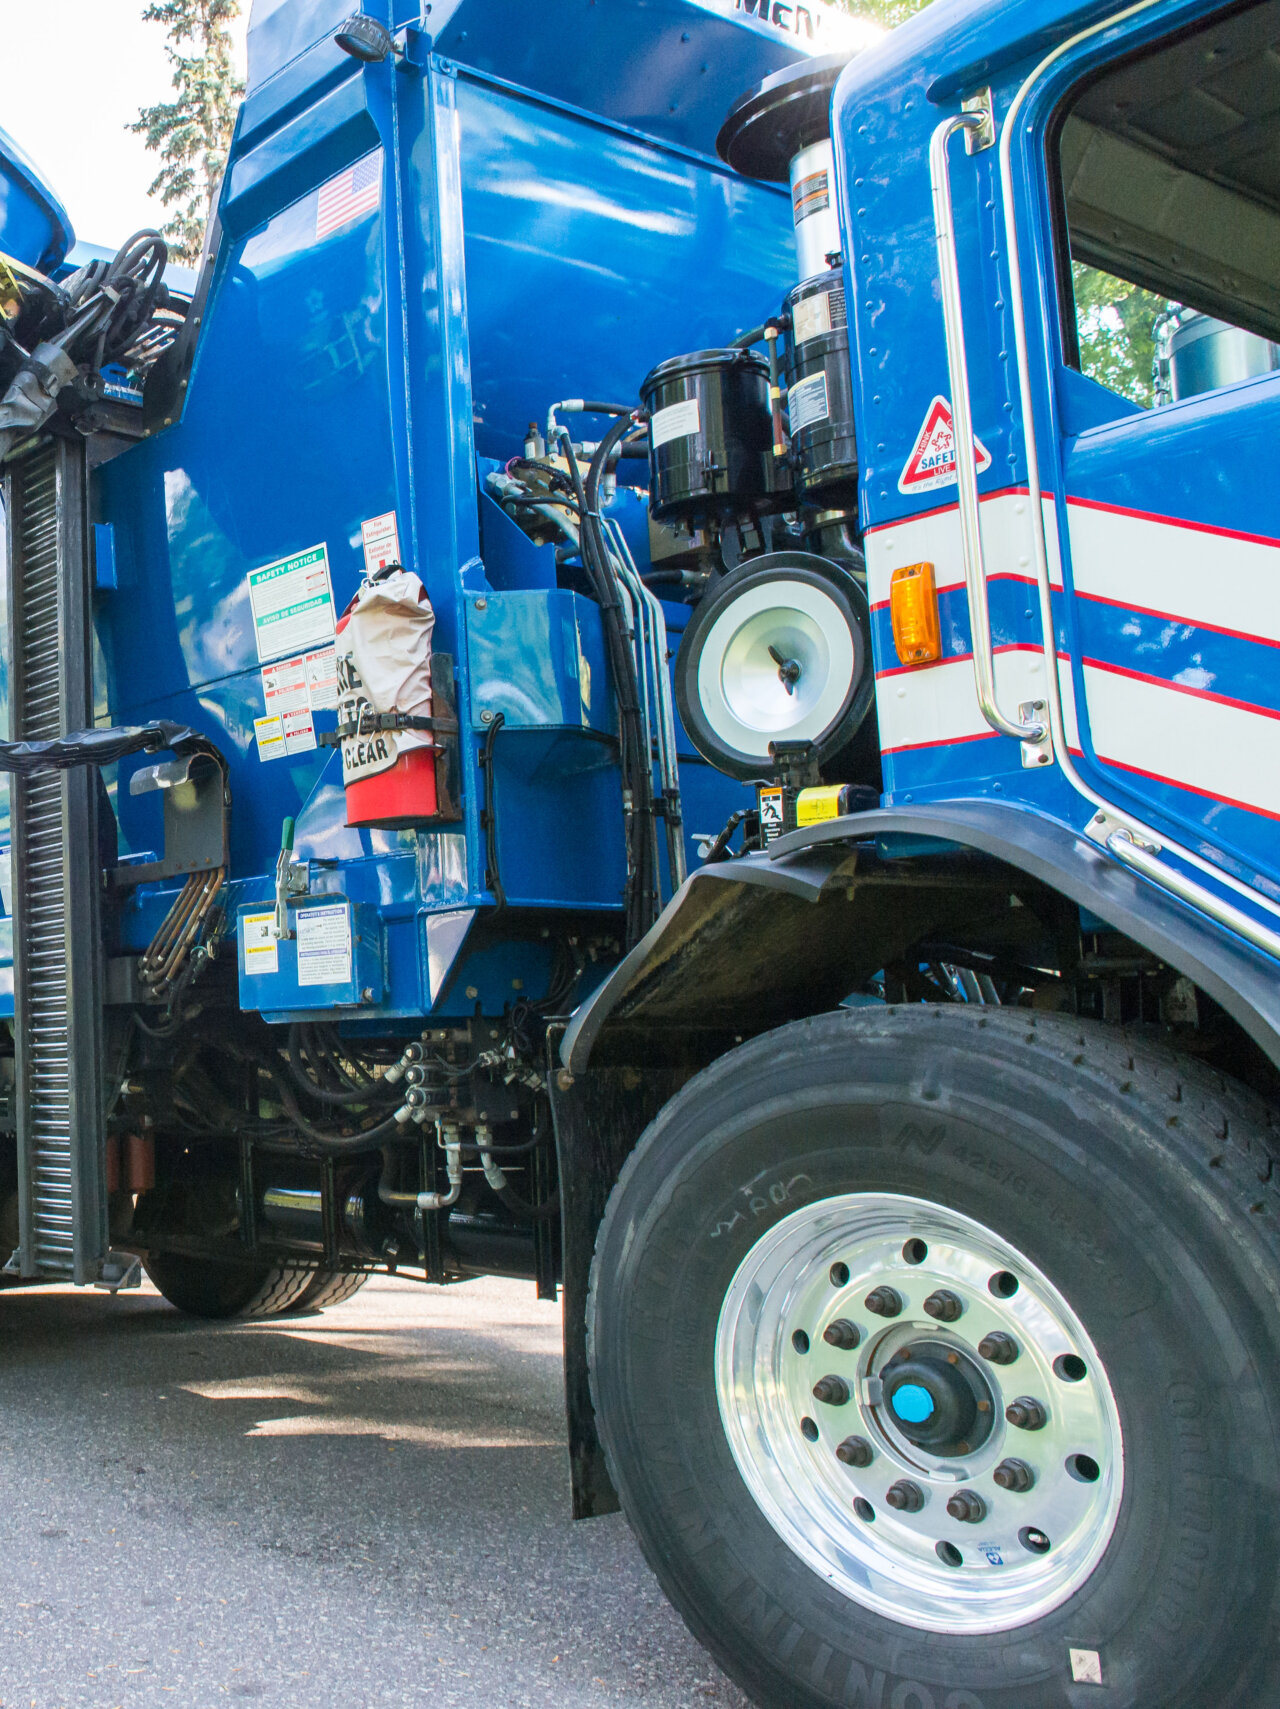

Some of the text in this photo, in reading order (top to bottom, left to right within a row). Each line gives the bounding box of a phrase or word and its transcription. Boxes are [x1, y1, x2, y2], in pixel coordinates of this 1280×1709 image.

[917, 431, 931, 456] THINK
[921, 449, 955, 470] SAFET
[933, 463, 951, 475] LIVE
[256, 554, 318, 583] SAFETY NOTICE
[281, 609, 289, 617] DE
[290, 597, 323, 615] SEGURIDAD
[344, 738, 389, 771] CLEAR
